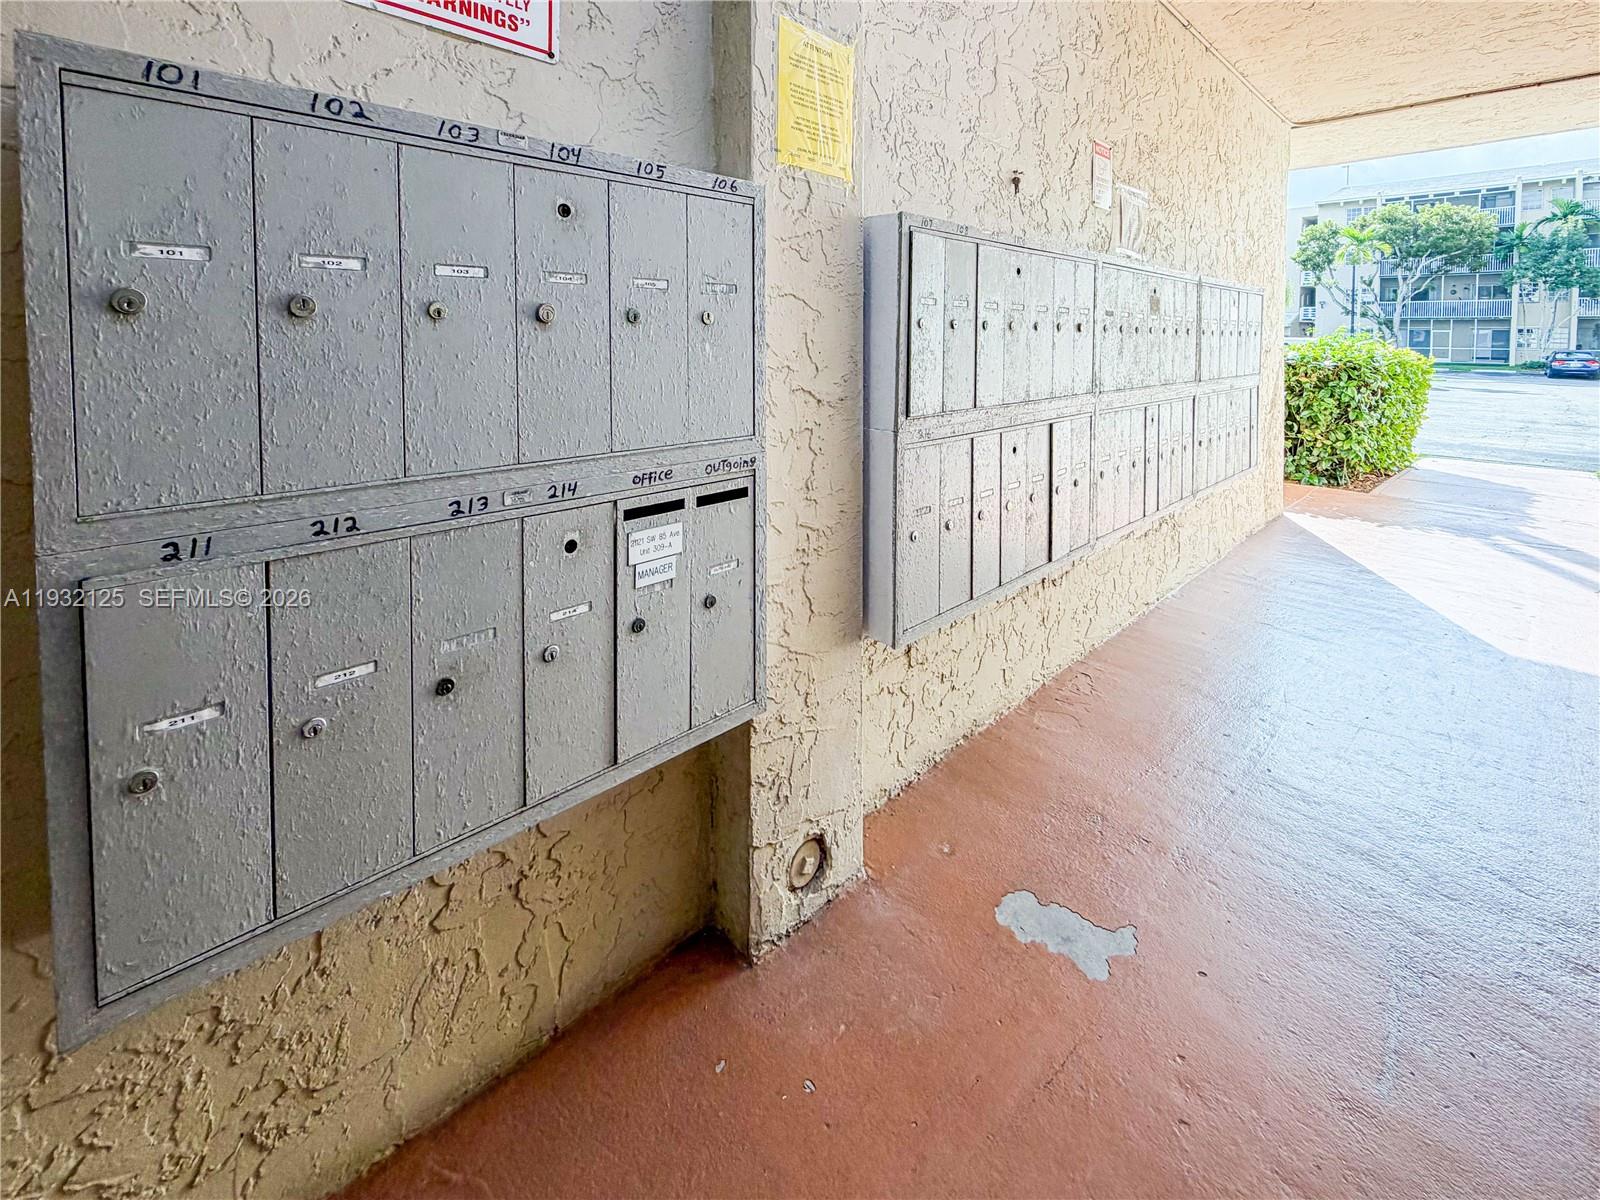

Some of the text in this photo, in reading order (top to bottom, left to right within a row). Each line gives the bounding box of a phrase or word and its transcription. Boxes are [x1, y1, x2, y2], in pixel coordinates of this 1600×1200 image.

[416, 0, 531, 32] ARNINGS”
[142, 60, 200, 91] 101
[309, 93, 374, 122] 102
[437, 119, 480, 143] 103
[549, 142, 582, 165] 104
[636, 161, 667, 179] 105
[711, 176, 738, 193] 106
[158, 249, 184, 257] 101
[320, 260, 343, 268] 102
[547, 481, 578, 499] 214
[448, 496, 488, 517] 213
[310, 516, 361, 537] 212
[646, 535, 656, 544] SW
[669, 530, 680, 538] Ave
[161, 536, 212, 562] 211
[637, 562, 673, 580] MANAGER
[334, 670, 356, 680] 212
[168, 715, 196, 727] 211
